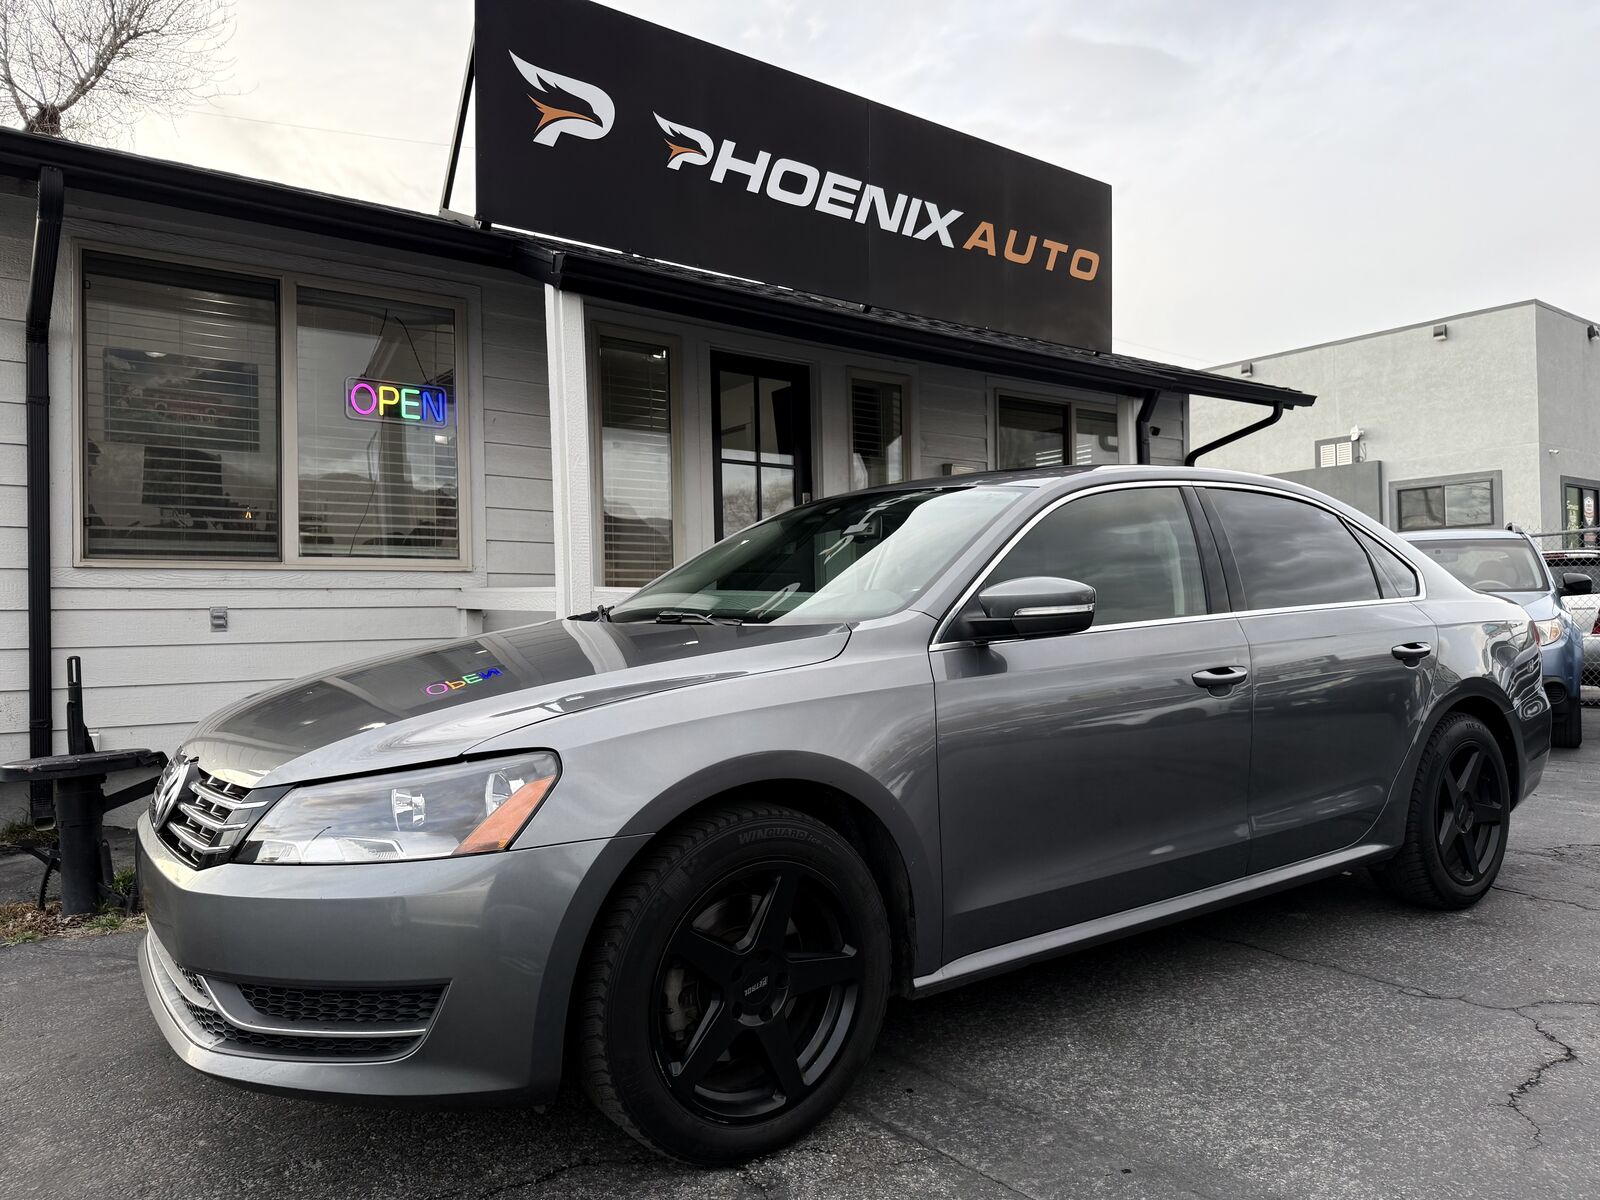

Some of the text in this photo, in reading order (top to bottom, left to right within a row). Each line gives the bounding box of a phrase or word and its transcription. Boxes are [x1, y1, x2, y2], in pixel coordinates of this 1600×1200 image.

[653, 110, 1100, 282] PHOENIX AUTO
[350, 383, 443, 422] OPEN
[738, 827, 808, 845] WINGUARD
